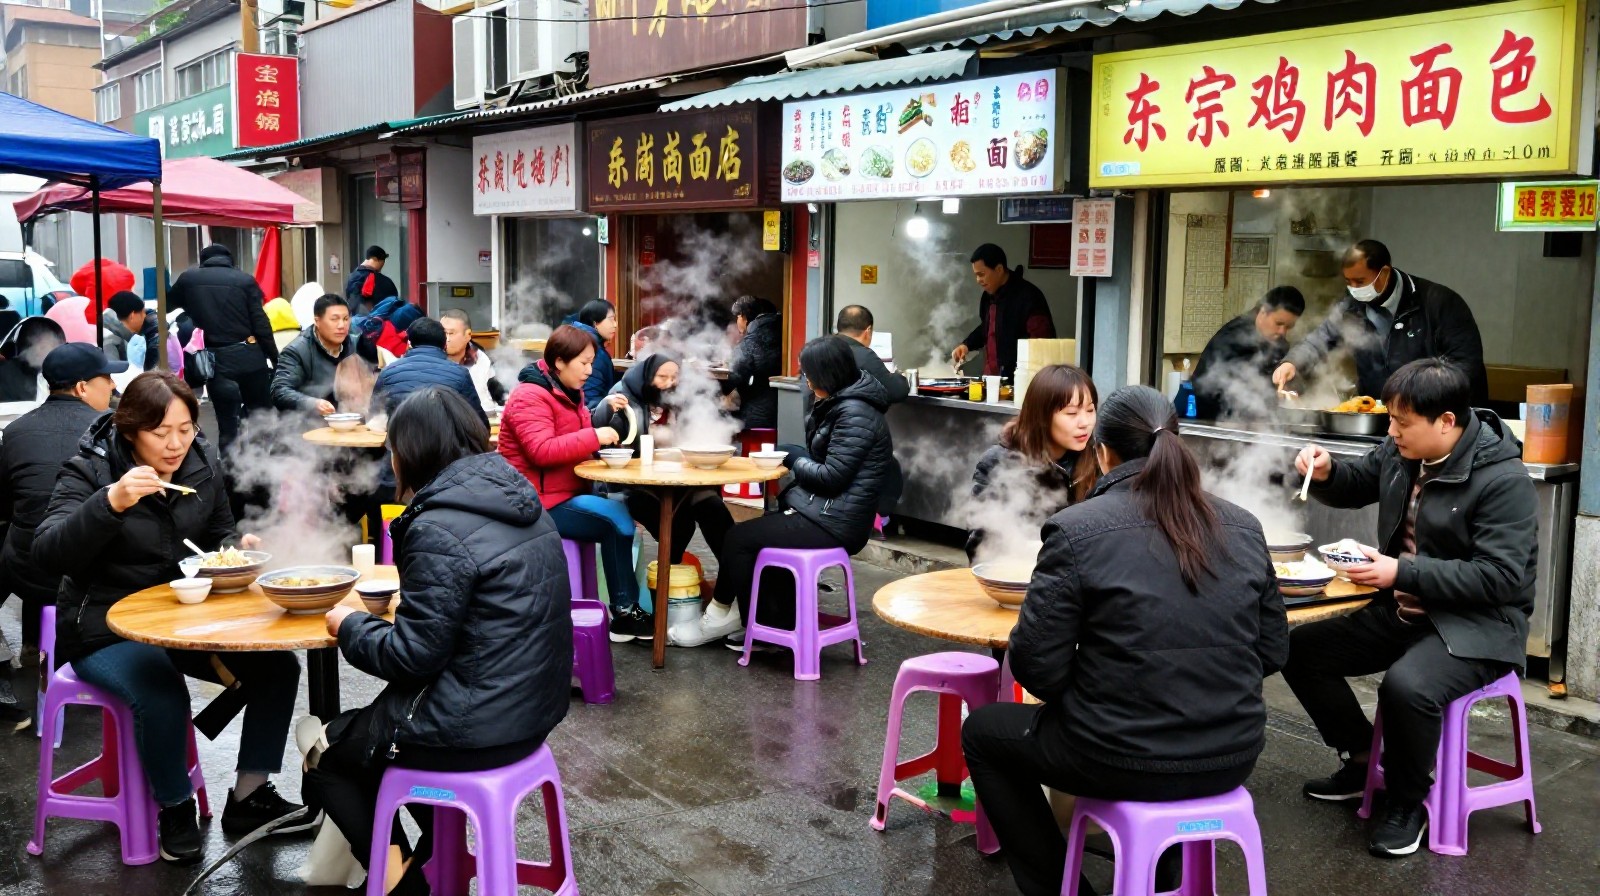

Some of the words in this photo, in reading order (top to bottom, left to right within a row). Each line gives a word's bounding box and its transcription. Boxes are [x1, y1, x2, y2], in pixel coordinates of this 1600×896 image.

[1123, 29, 1552, 152] 东宗鸡肉面色
